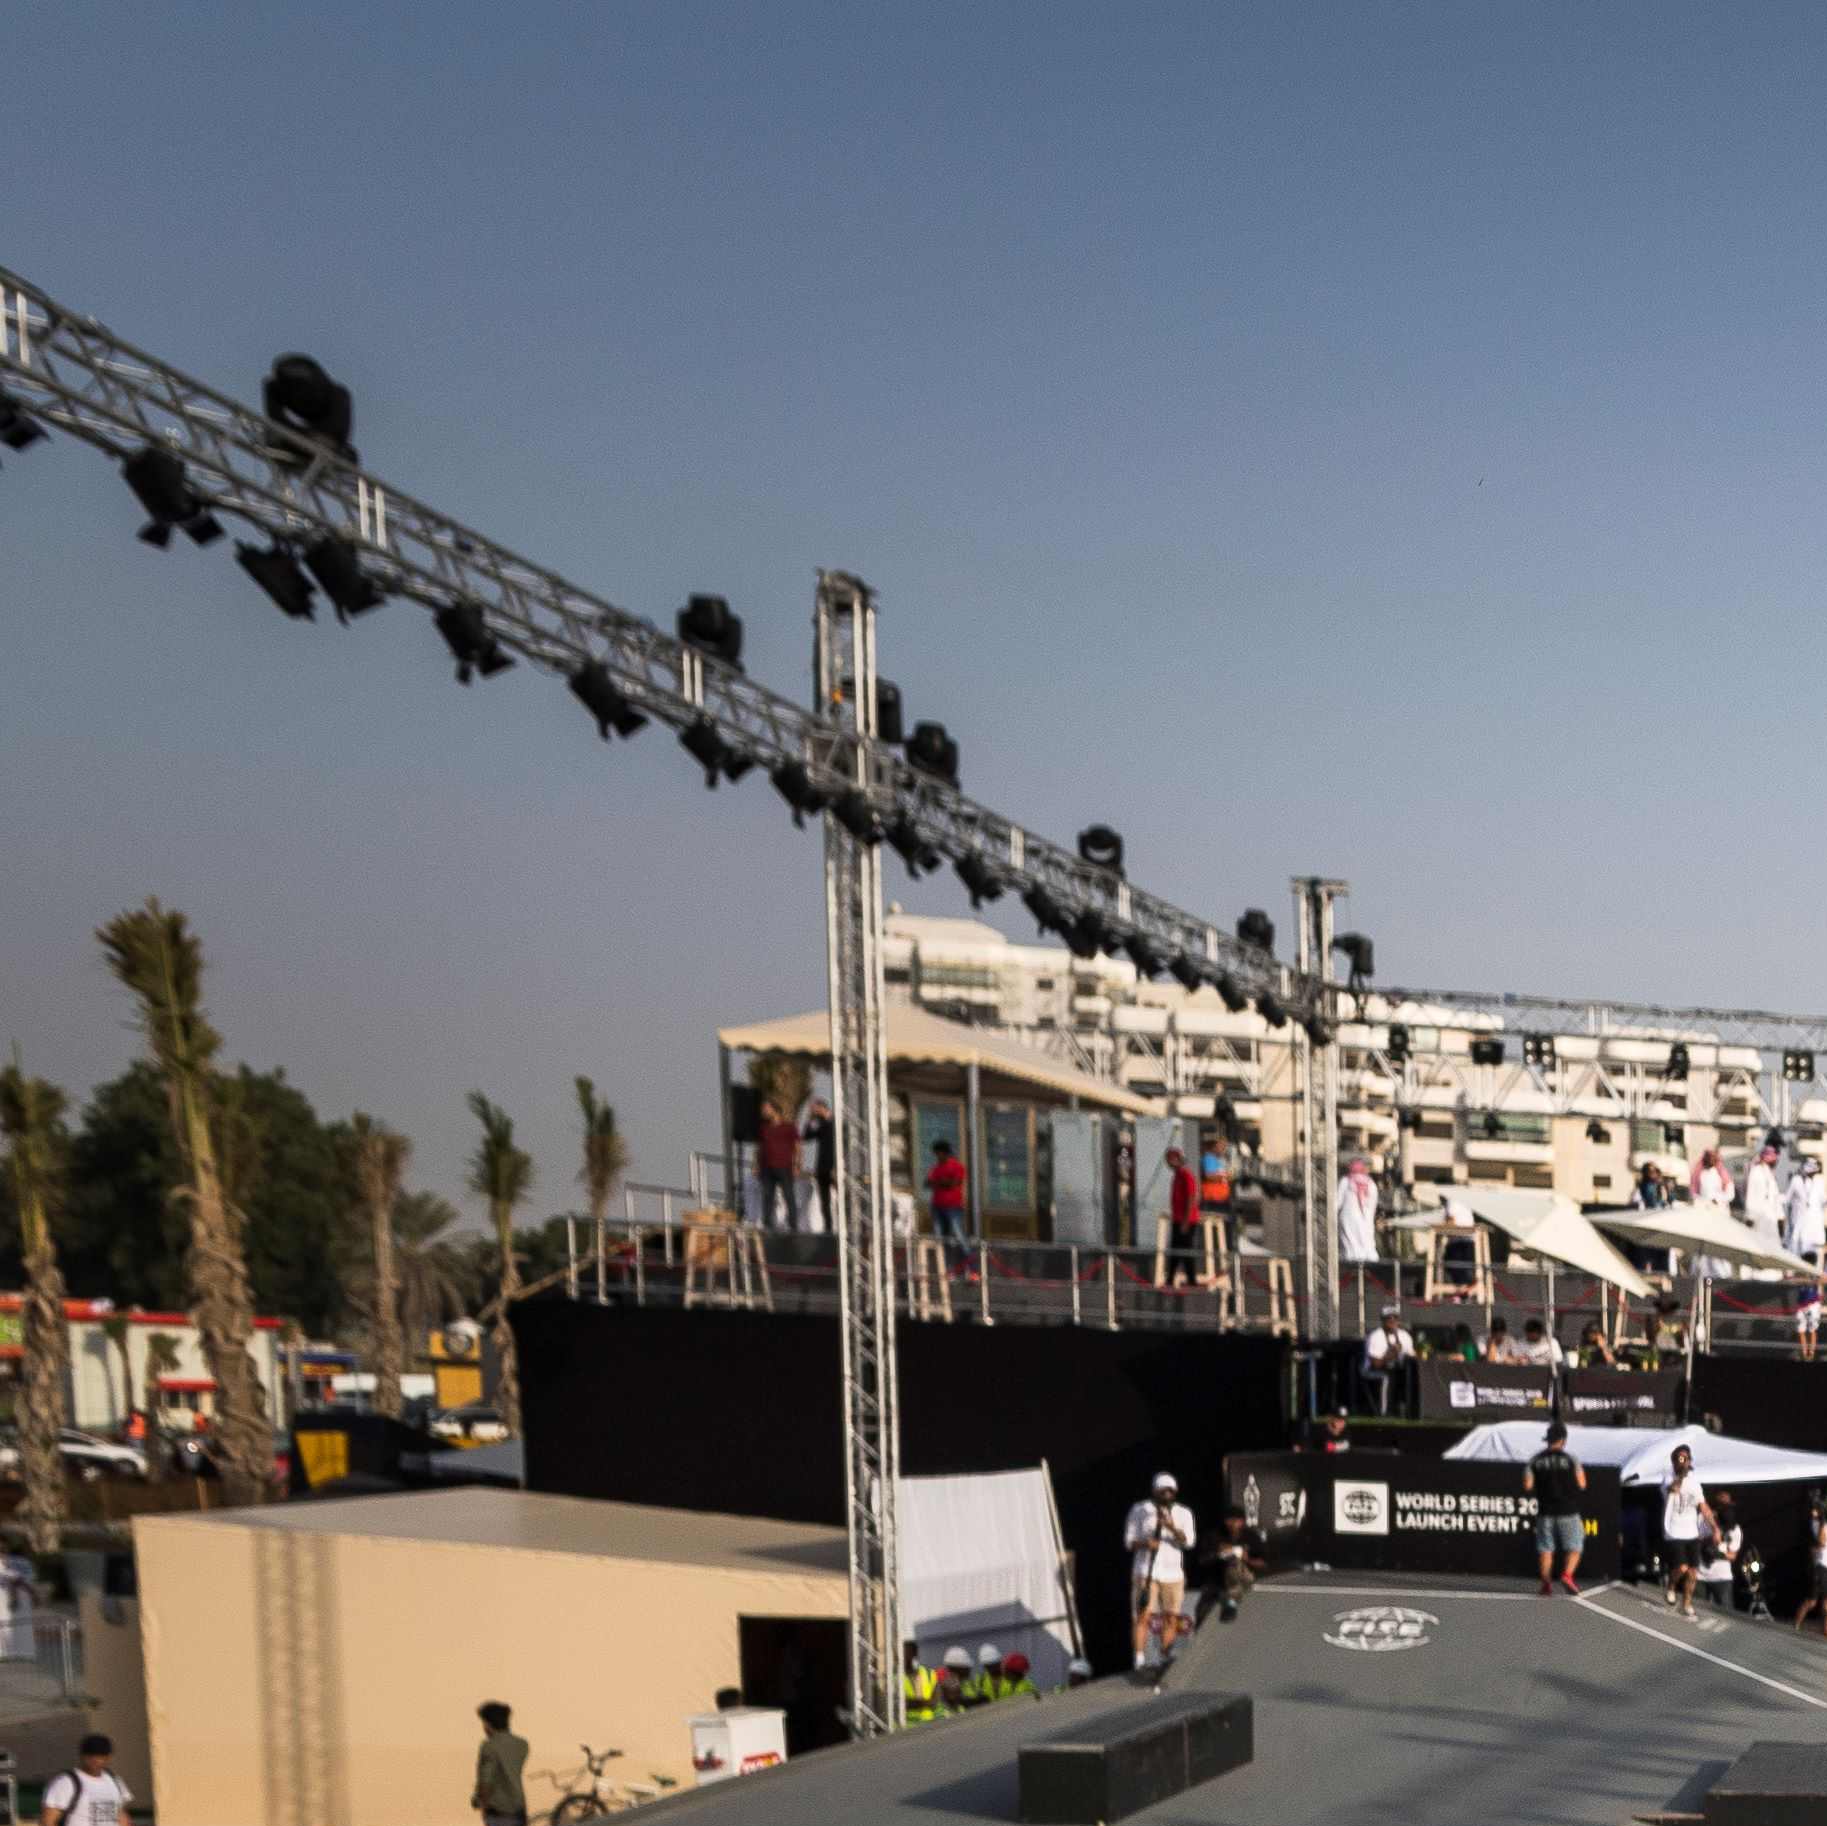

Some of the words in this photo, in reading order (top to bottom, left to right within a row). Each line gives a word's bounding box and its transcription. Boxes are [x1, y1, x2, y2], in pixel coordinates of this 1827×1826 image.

[1395, 1491, 1457, 1512] WORLD
[1459, 1493, 1516, 1515] SERIES
[1518, 1497, 1539, 1516] 20
[1396, 1512, 1464, 1531] LAUNCH
[1467, 1514, 1519, 1533] EVENT
